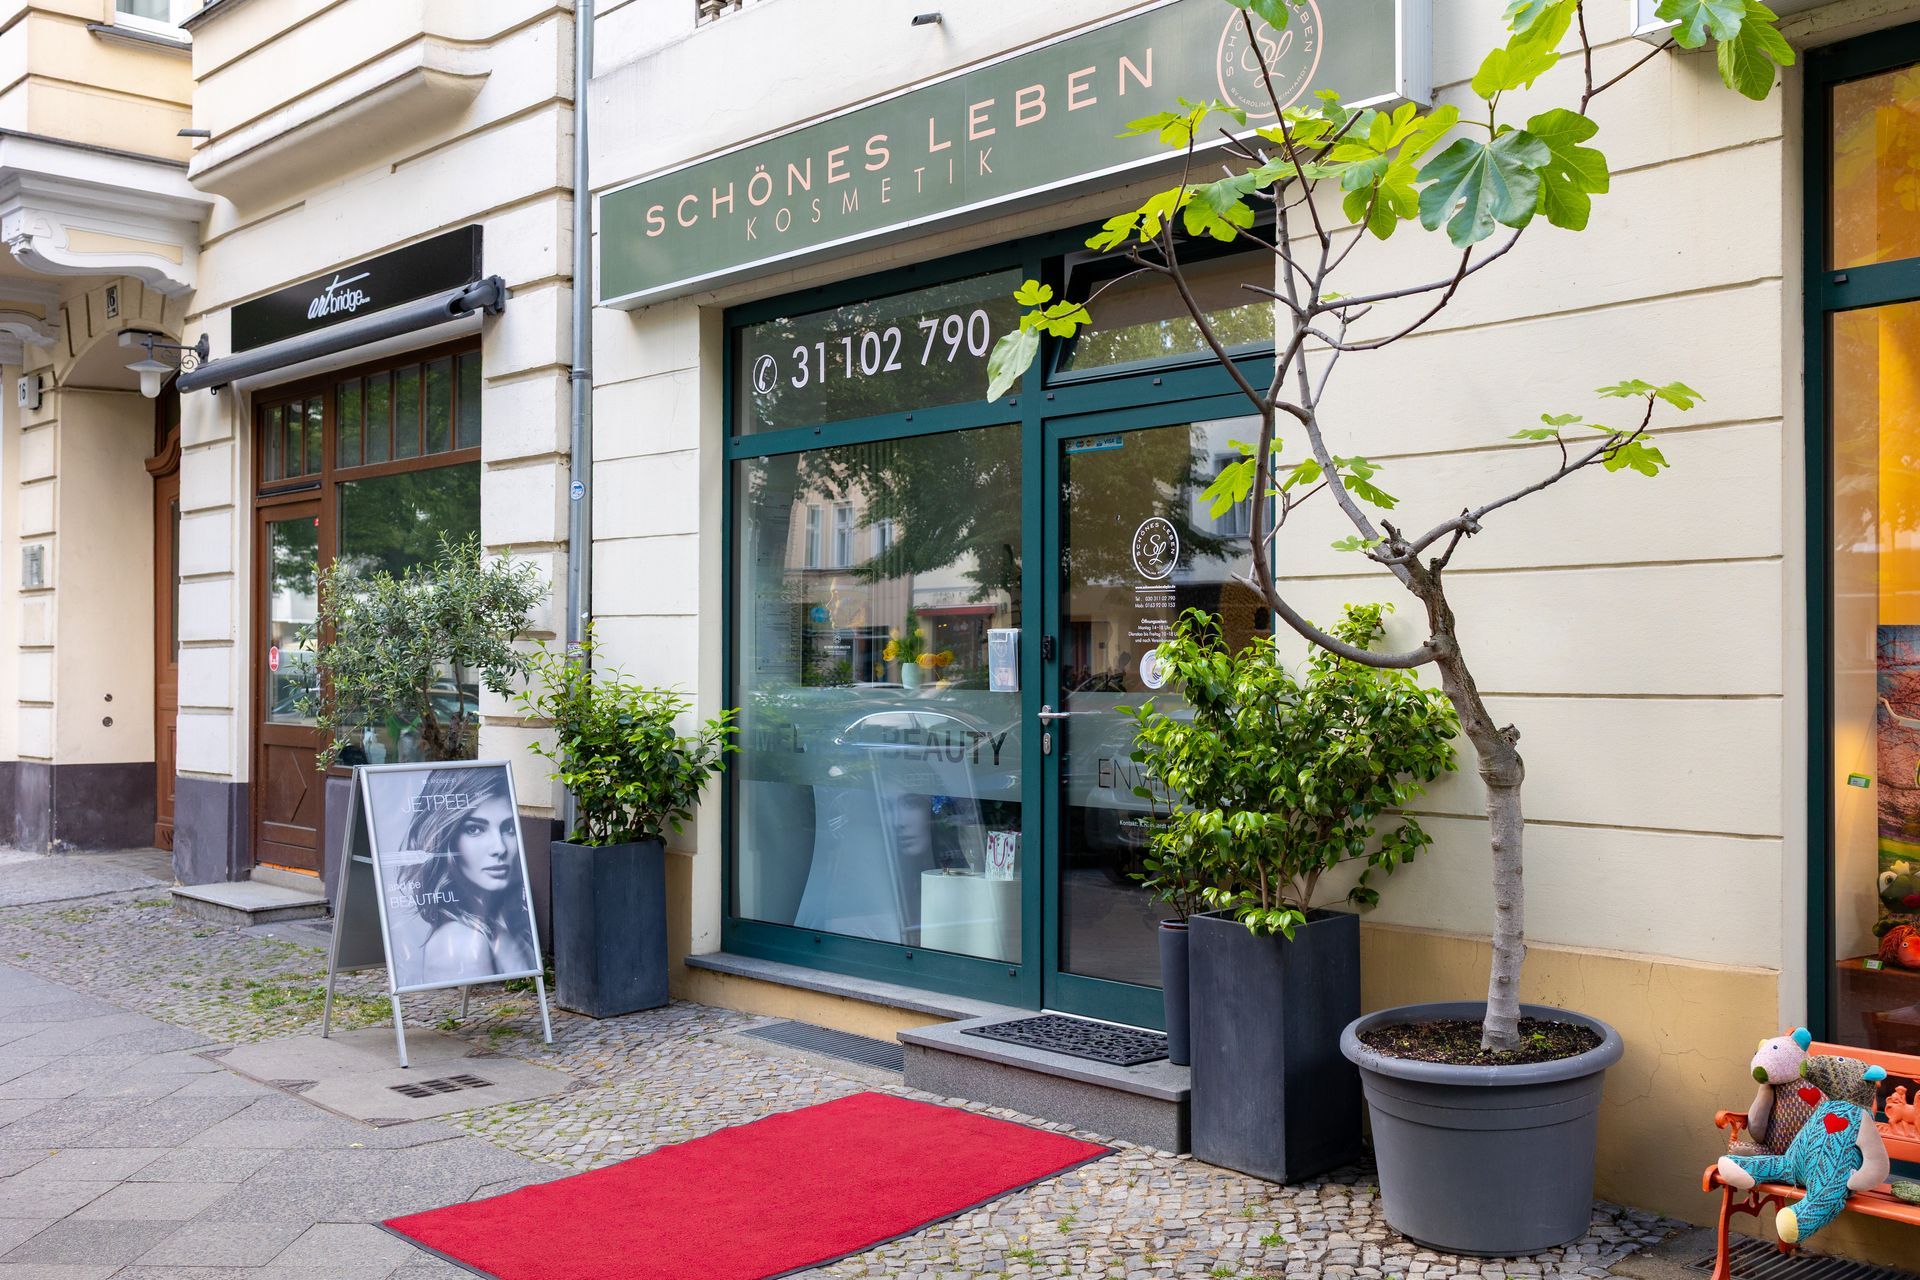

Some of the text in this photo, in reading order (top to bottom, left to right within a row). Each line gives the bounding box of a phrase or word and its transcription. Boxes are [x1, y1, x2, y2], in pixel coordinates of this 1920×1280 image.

[1277, 65, 1308, 101] EINHARDT
[646, 47, 1154, 238] SCHÖNES LEBEN
[746, 146, 993, 241] KOSMETIK
[791, 309, 990, 389] 31 102 790
[882, 727, 1008, 767] BEAUTY
[390, 890, 460, 909] BEAUTIFUL
[408, 880, 421, 890] be
